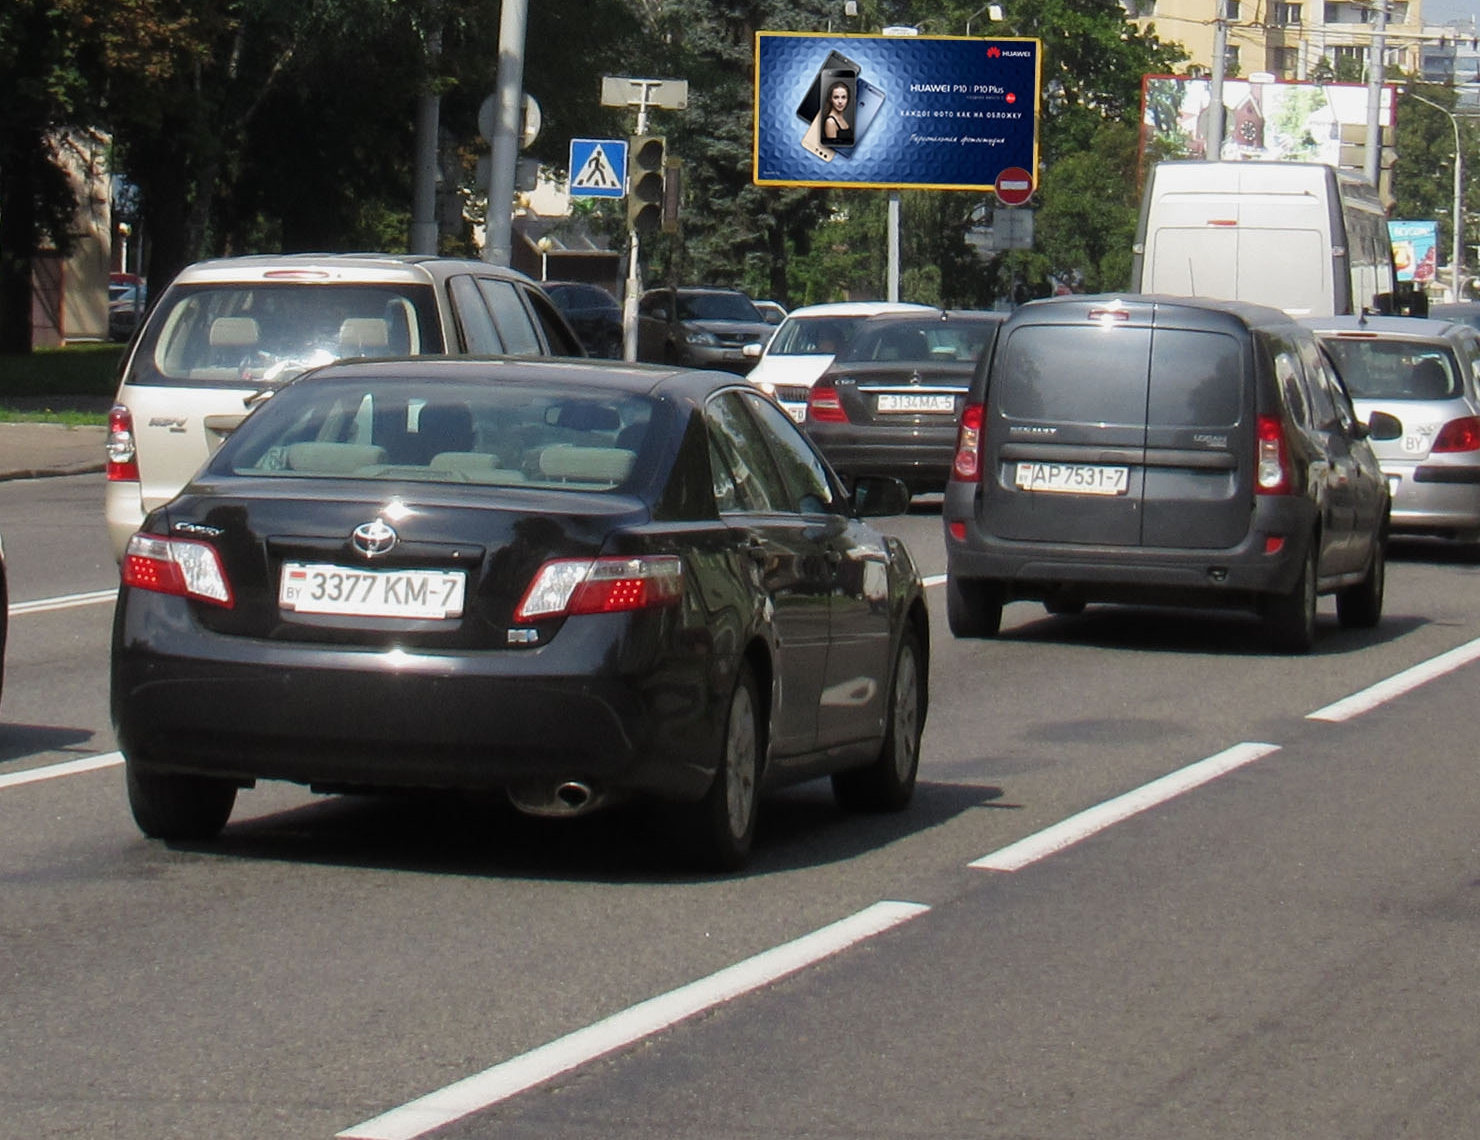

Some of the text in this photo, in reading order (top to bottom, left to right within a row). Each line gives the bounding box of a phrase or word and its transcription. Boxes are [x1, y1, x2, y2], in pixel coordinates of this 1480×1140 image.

[1002, 50, 1031, 58] HUAWEI
[910, 83, 1004, 94] HUAWEI P10 P10 Plus
[900, 110, 930, 118] КАЖДОЕ
[934, 110, 953, 118] ФОТО
[1406, 436, 1422, 451] BY
[286, 571, 458, 608] BY 3377 KM-7
